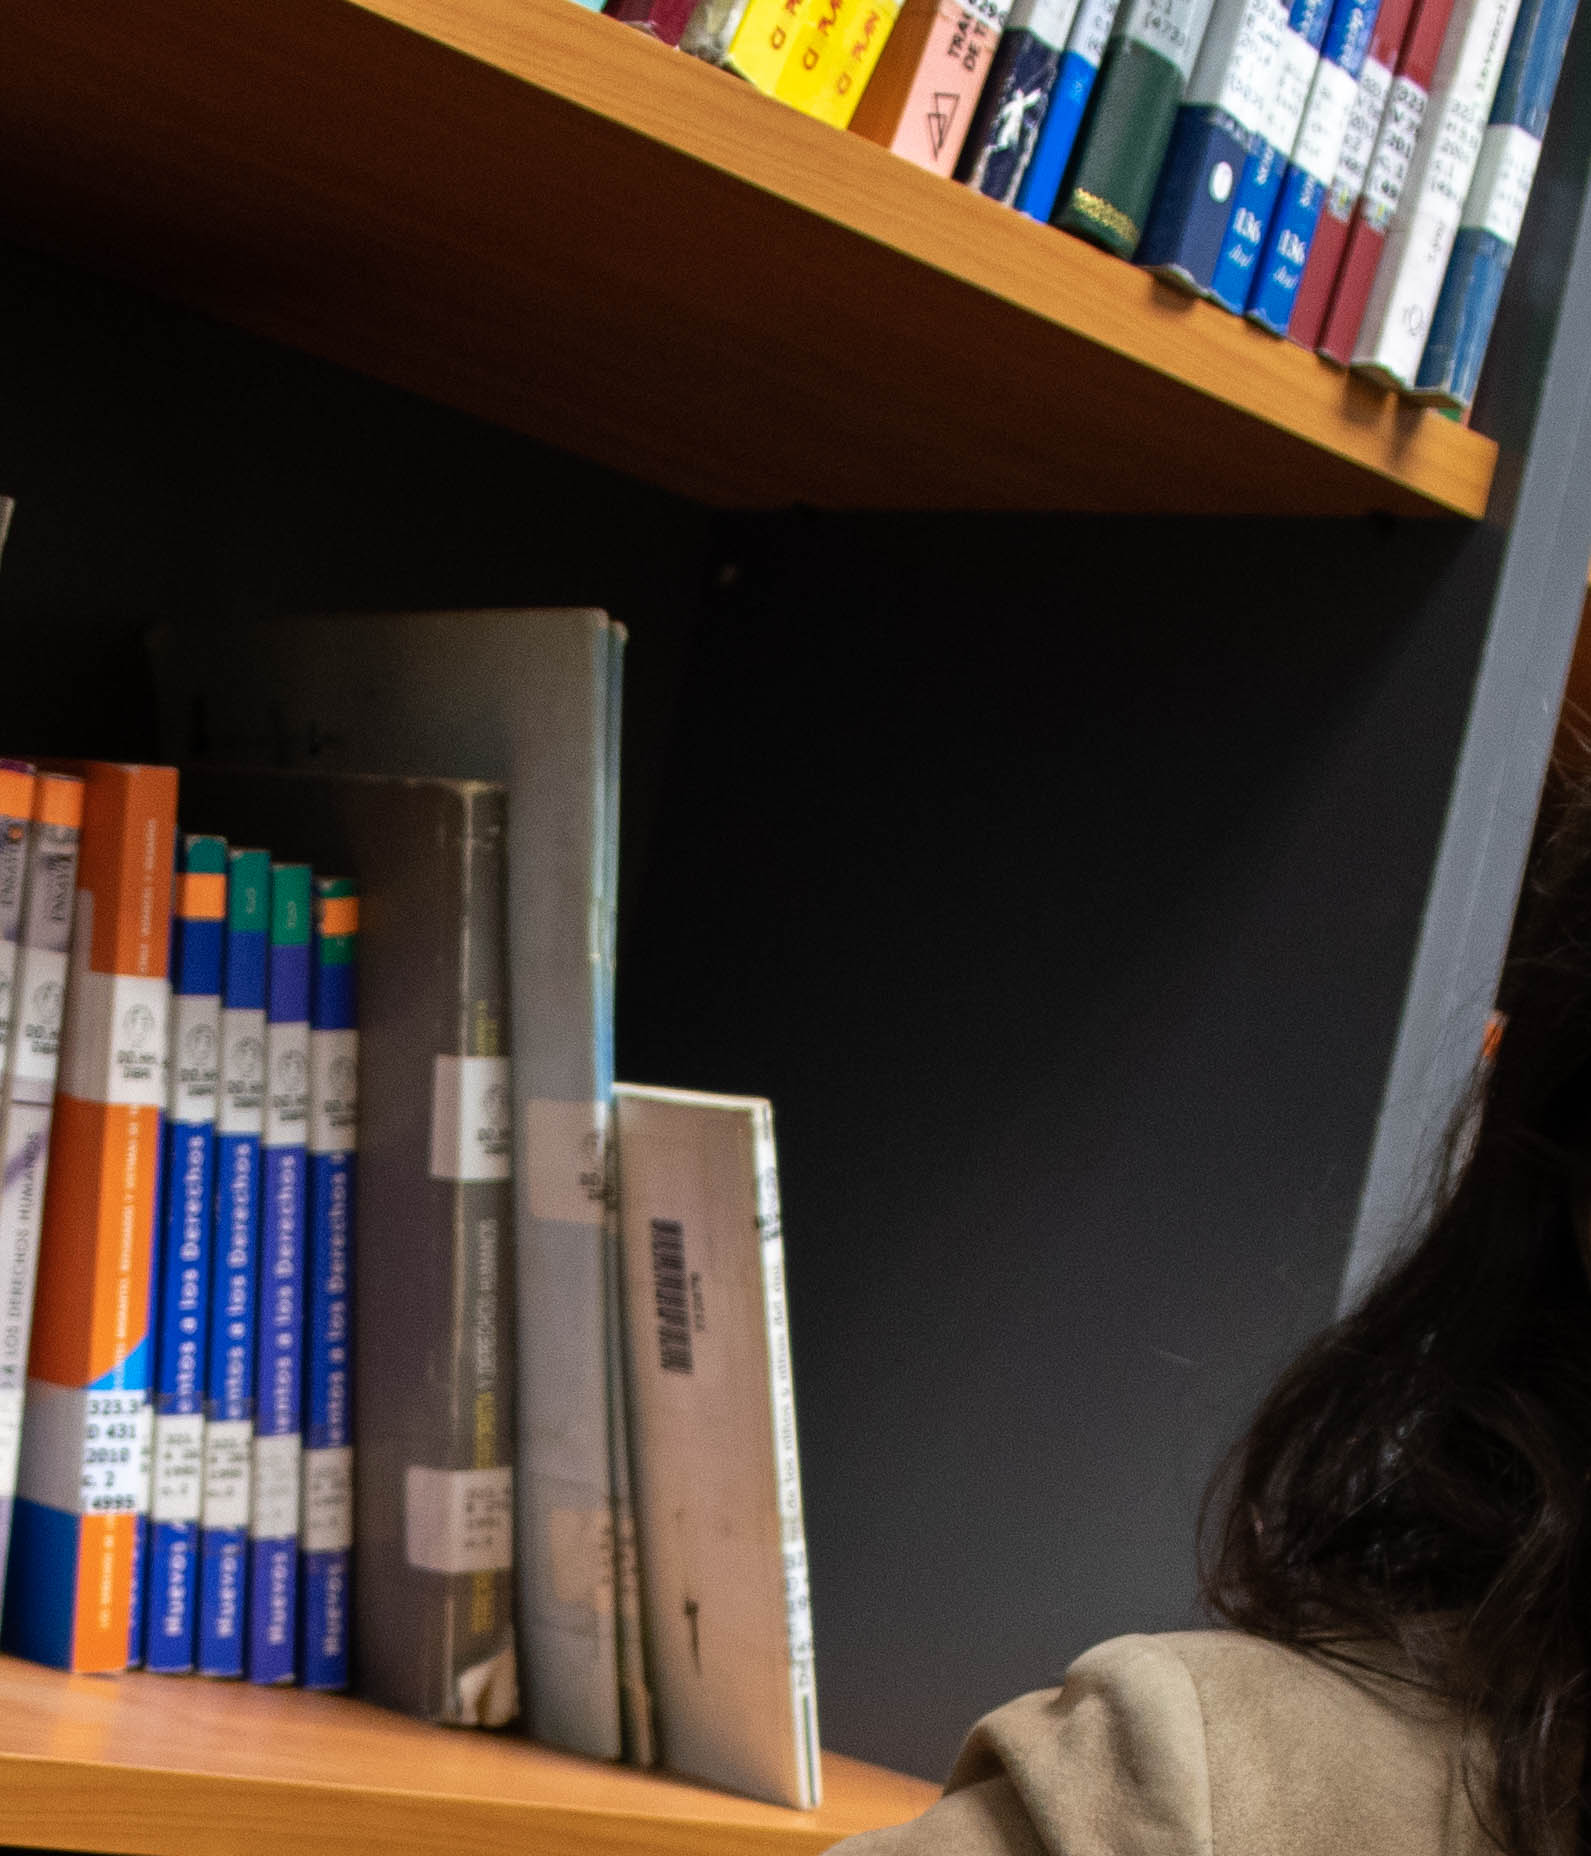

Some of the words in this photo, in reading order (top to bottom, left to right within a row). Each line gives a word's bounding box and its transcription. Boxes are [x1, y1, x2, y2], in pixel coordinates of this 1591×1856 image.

[180, 1135, 204, 1261] Derechos
[227, 1144, 251, 1269] Derechos
[274, 1155, 296, 1278] Derechos
[325, 1172, 346, 1294] Derechos
[179, 1268, 199, 1310] los
[227, 1275, 246, 1316] los
[275, 1285, 294, 1327] los
[326, 1301, 345, 1341] los
